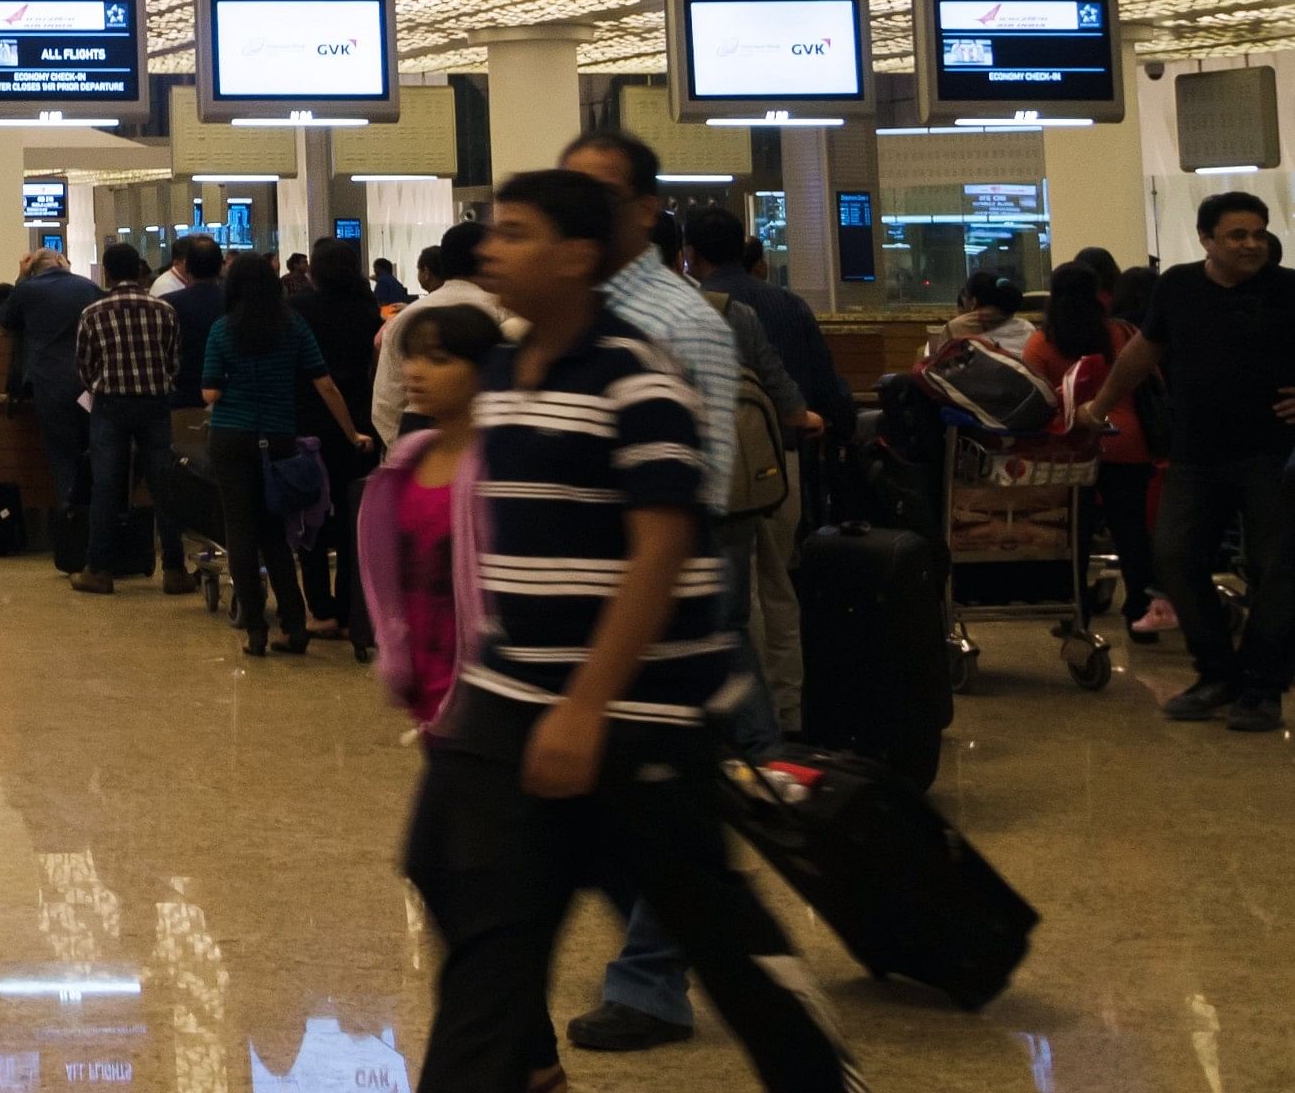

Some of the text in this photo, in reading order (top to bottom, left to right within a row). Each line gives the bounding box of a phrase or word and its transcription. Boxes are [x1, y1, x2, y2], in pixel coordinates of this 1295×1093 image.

[41, 48, 106, 60] ALL FLIGHTS
[317, 44, 351, 56] GVK
[791, 44, 825, 56] GVK
[14, 72, 86, 81] ECONOMY CHECK-IN
[988, 72, 1061, 81] ECONOMY CHECK-IN
[12, 82, 41, 92] CLOSES
[57, 82, 79, 92] PRIOR
[80, 82, 124, 92] DEPARTURE
